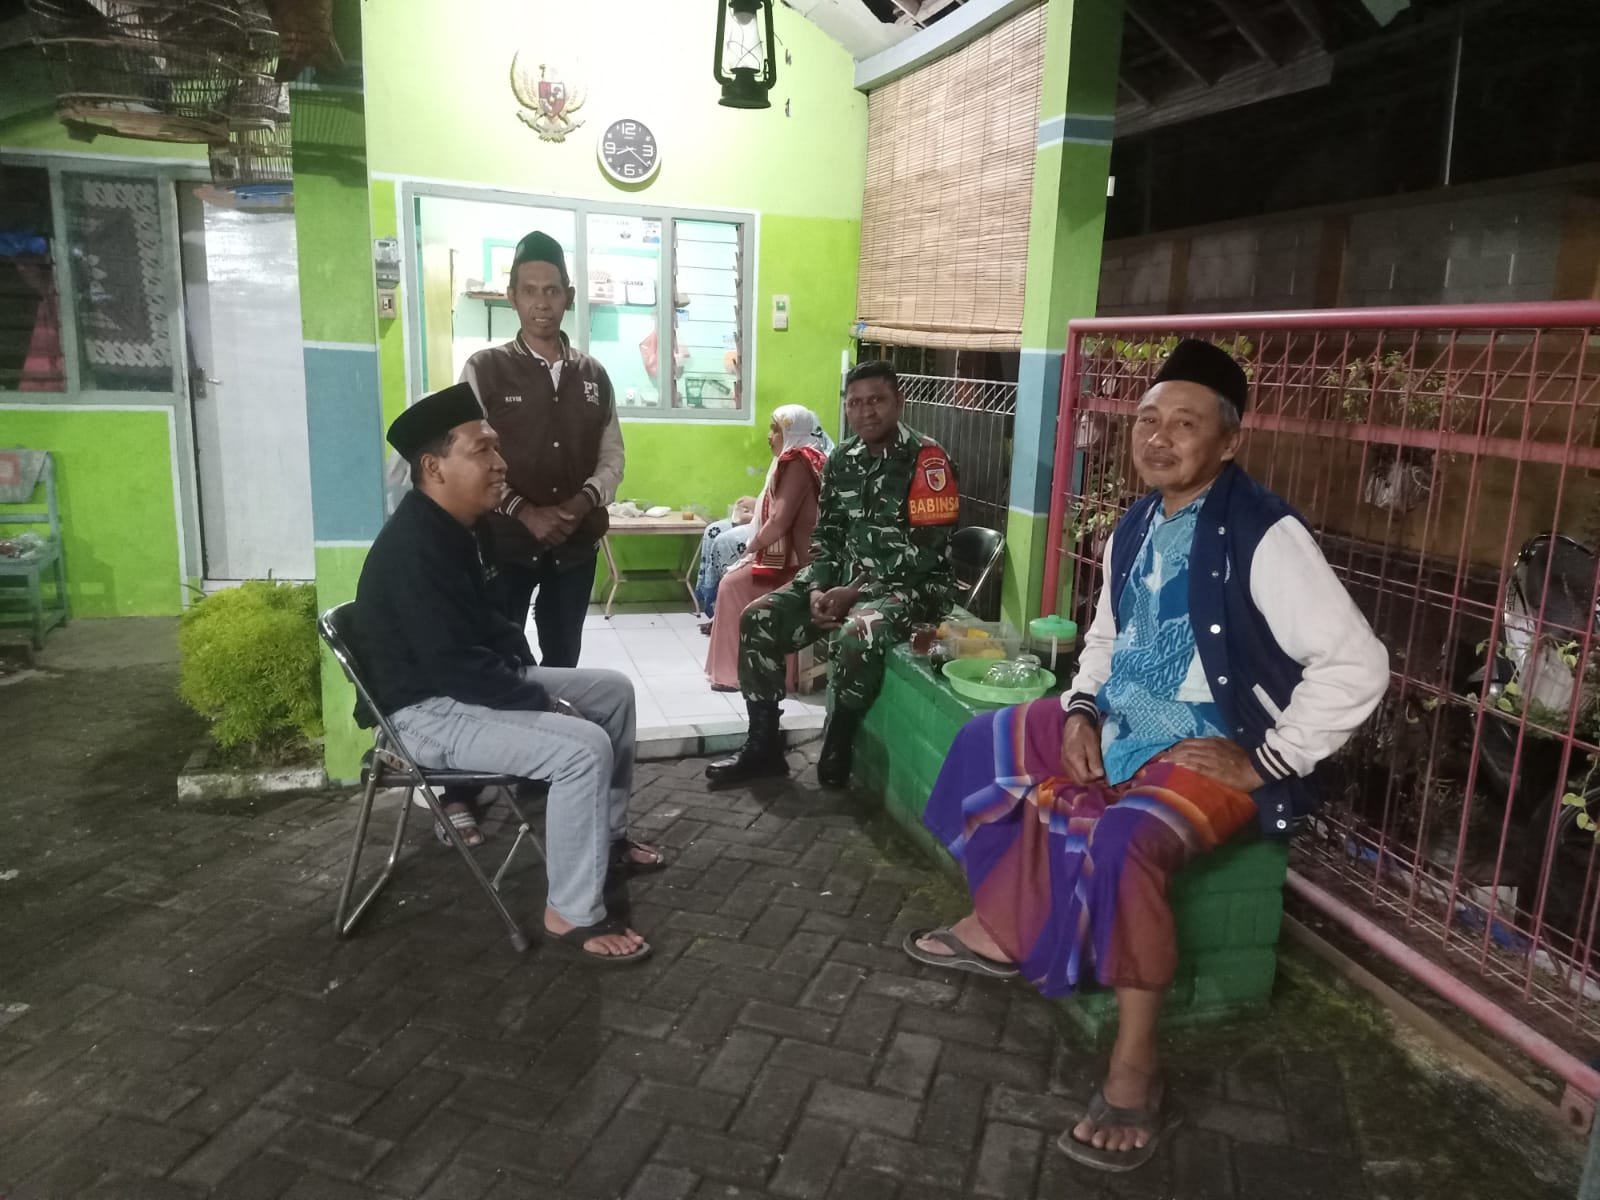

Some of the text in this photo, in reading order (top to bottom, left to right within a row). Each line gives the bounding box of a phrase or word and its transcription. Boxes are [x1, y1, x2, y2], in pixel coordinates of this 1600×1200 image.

[622, 122, 636, 136] 12
[605, 141, 616, 154] 9
[642, 144, 654, 157] 3
[624, 163, 635, 176] 6
